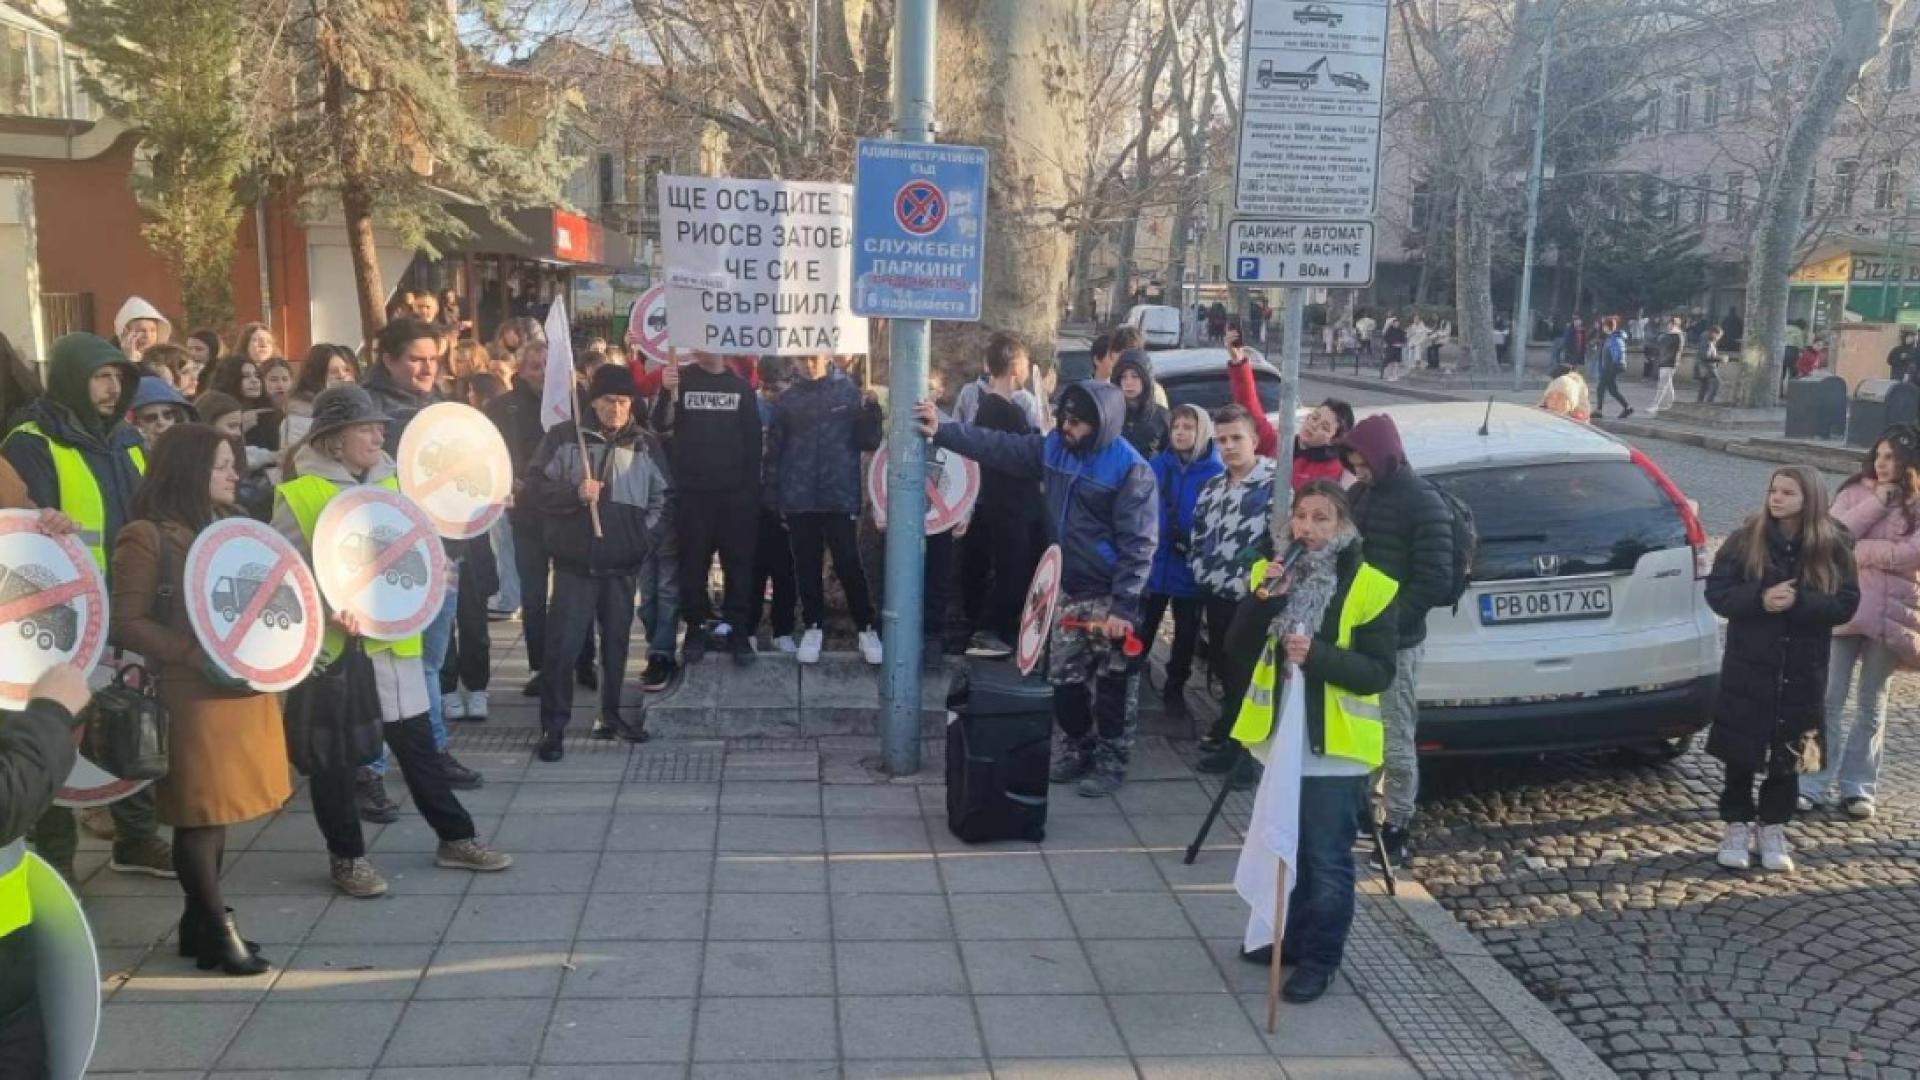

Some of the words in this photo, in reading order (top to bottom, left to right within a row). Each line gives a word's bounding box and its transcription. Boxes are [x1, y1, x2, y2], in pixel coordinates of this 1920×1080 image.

[668, 186, 707, 212] ЩЕ
[716, 189, 831, 216] ОСЪДИТЕ
[677, 220, 762, 247] РИОСВ
[1238, 225, 1296, 239] ПАРКИНГ
[1303, 226, 1364, 240] АВТОМАТ
[863, 238, 976, 259] СЛУЖЕБЕН
[1239, 241, 1297, 256] PARKING
[1303, 242, 1361, 257] MACHINE
[725, 258, 758, 281] ЧЕ
[767, 259, 798, 281] СИ
[807, 260, 820, 281] Е
[873, 259, 967, 278] ПАРКИНГ
[702, 290, 841, 315] СВЪРШИЛА
[705, 324, 841, 348] РАБОТАТА?
[1495, 597, 1522, 616] PB
[1527, 591, 1574, 614] 0817
[1580, 590, 1605, 610] XC
